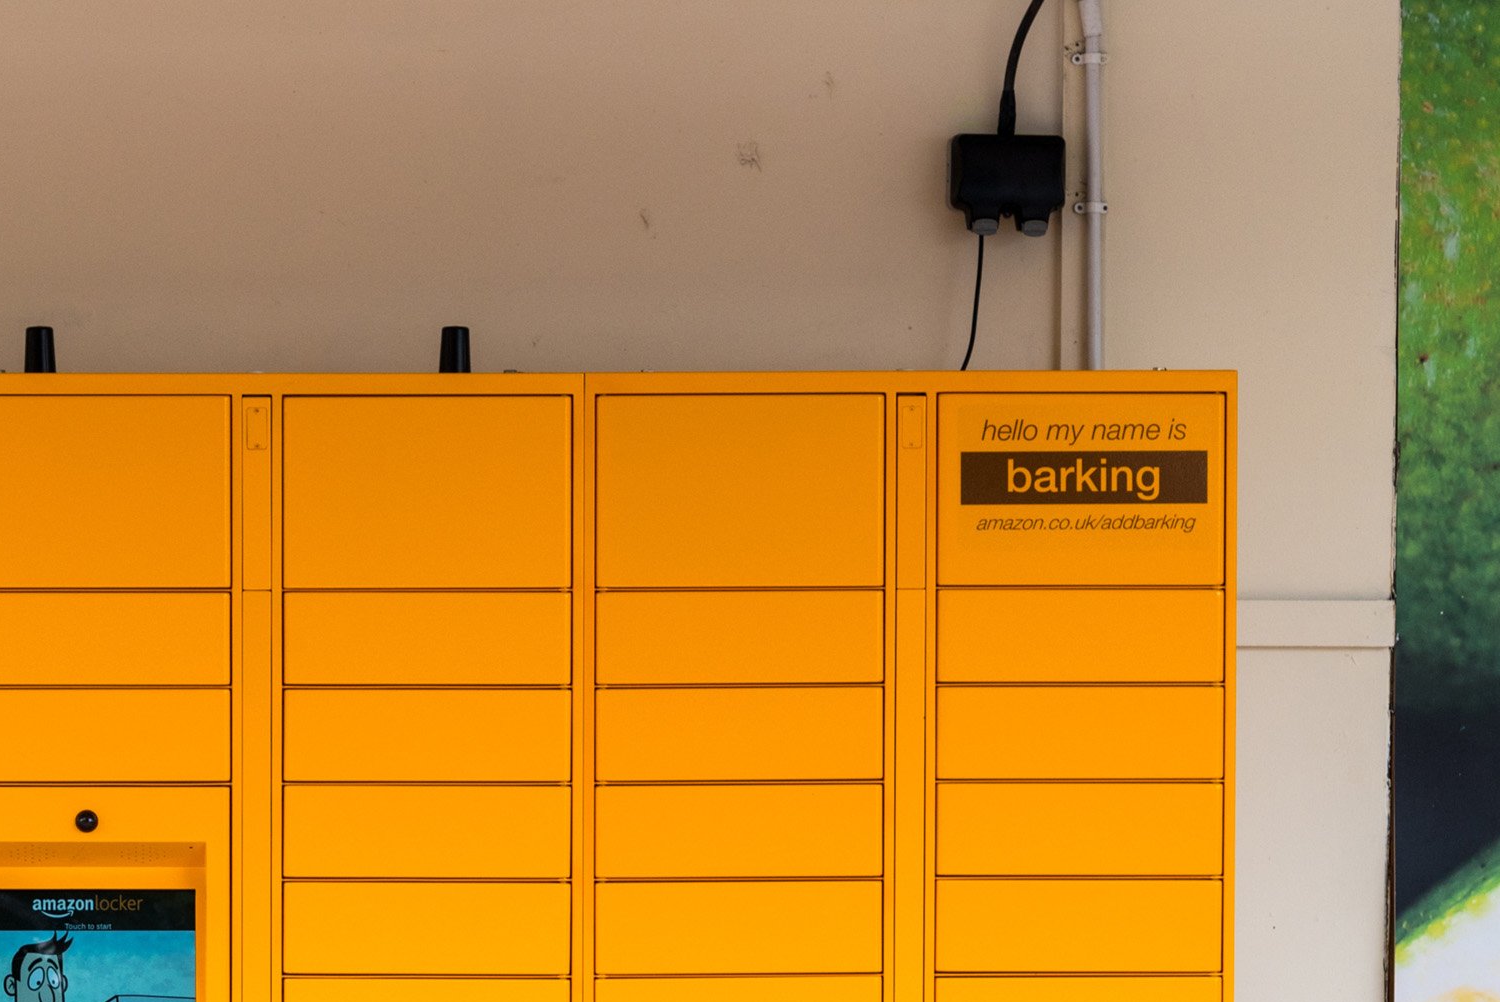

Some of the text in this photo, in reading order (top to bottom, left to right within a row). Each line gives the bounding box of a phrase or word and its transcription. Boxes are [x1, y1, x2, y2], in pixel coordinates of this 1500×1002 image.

[981, 418, 1187, 446] hello my name is
[1006, 458, 1161, 501] barking
[976, 514, 1197, 534] amazon.co.uk/addbarking
